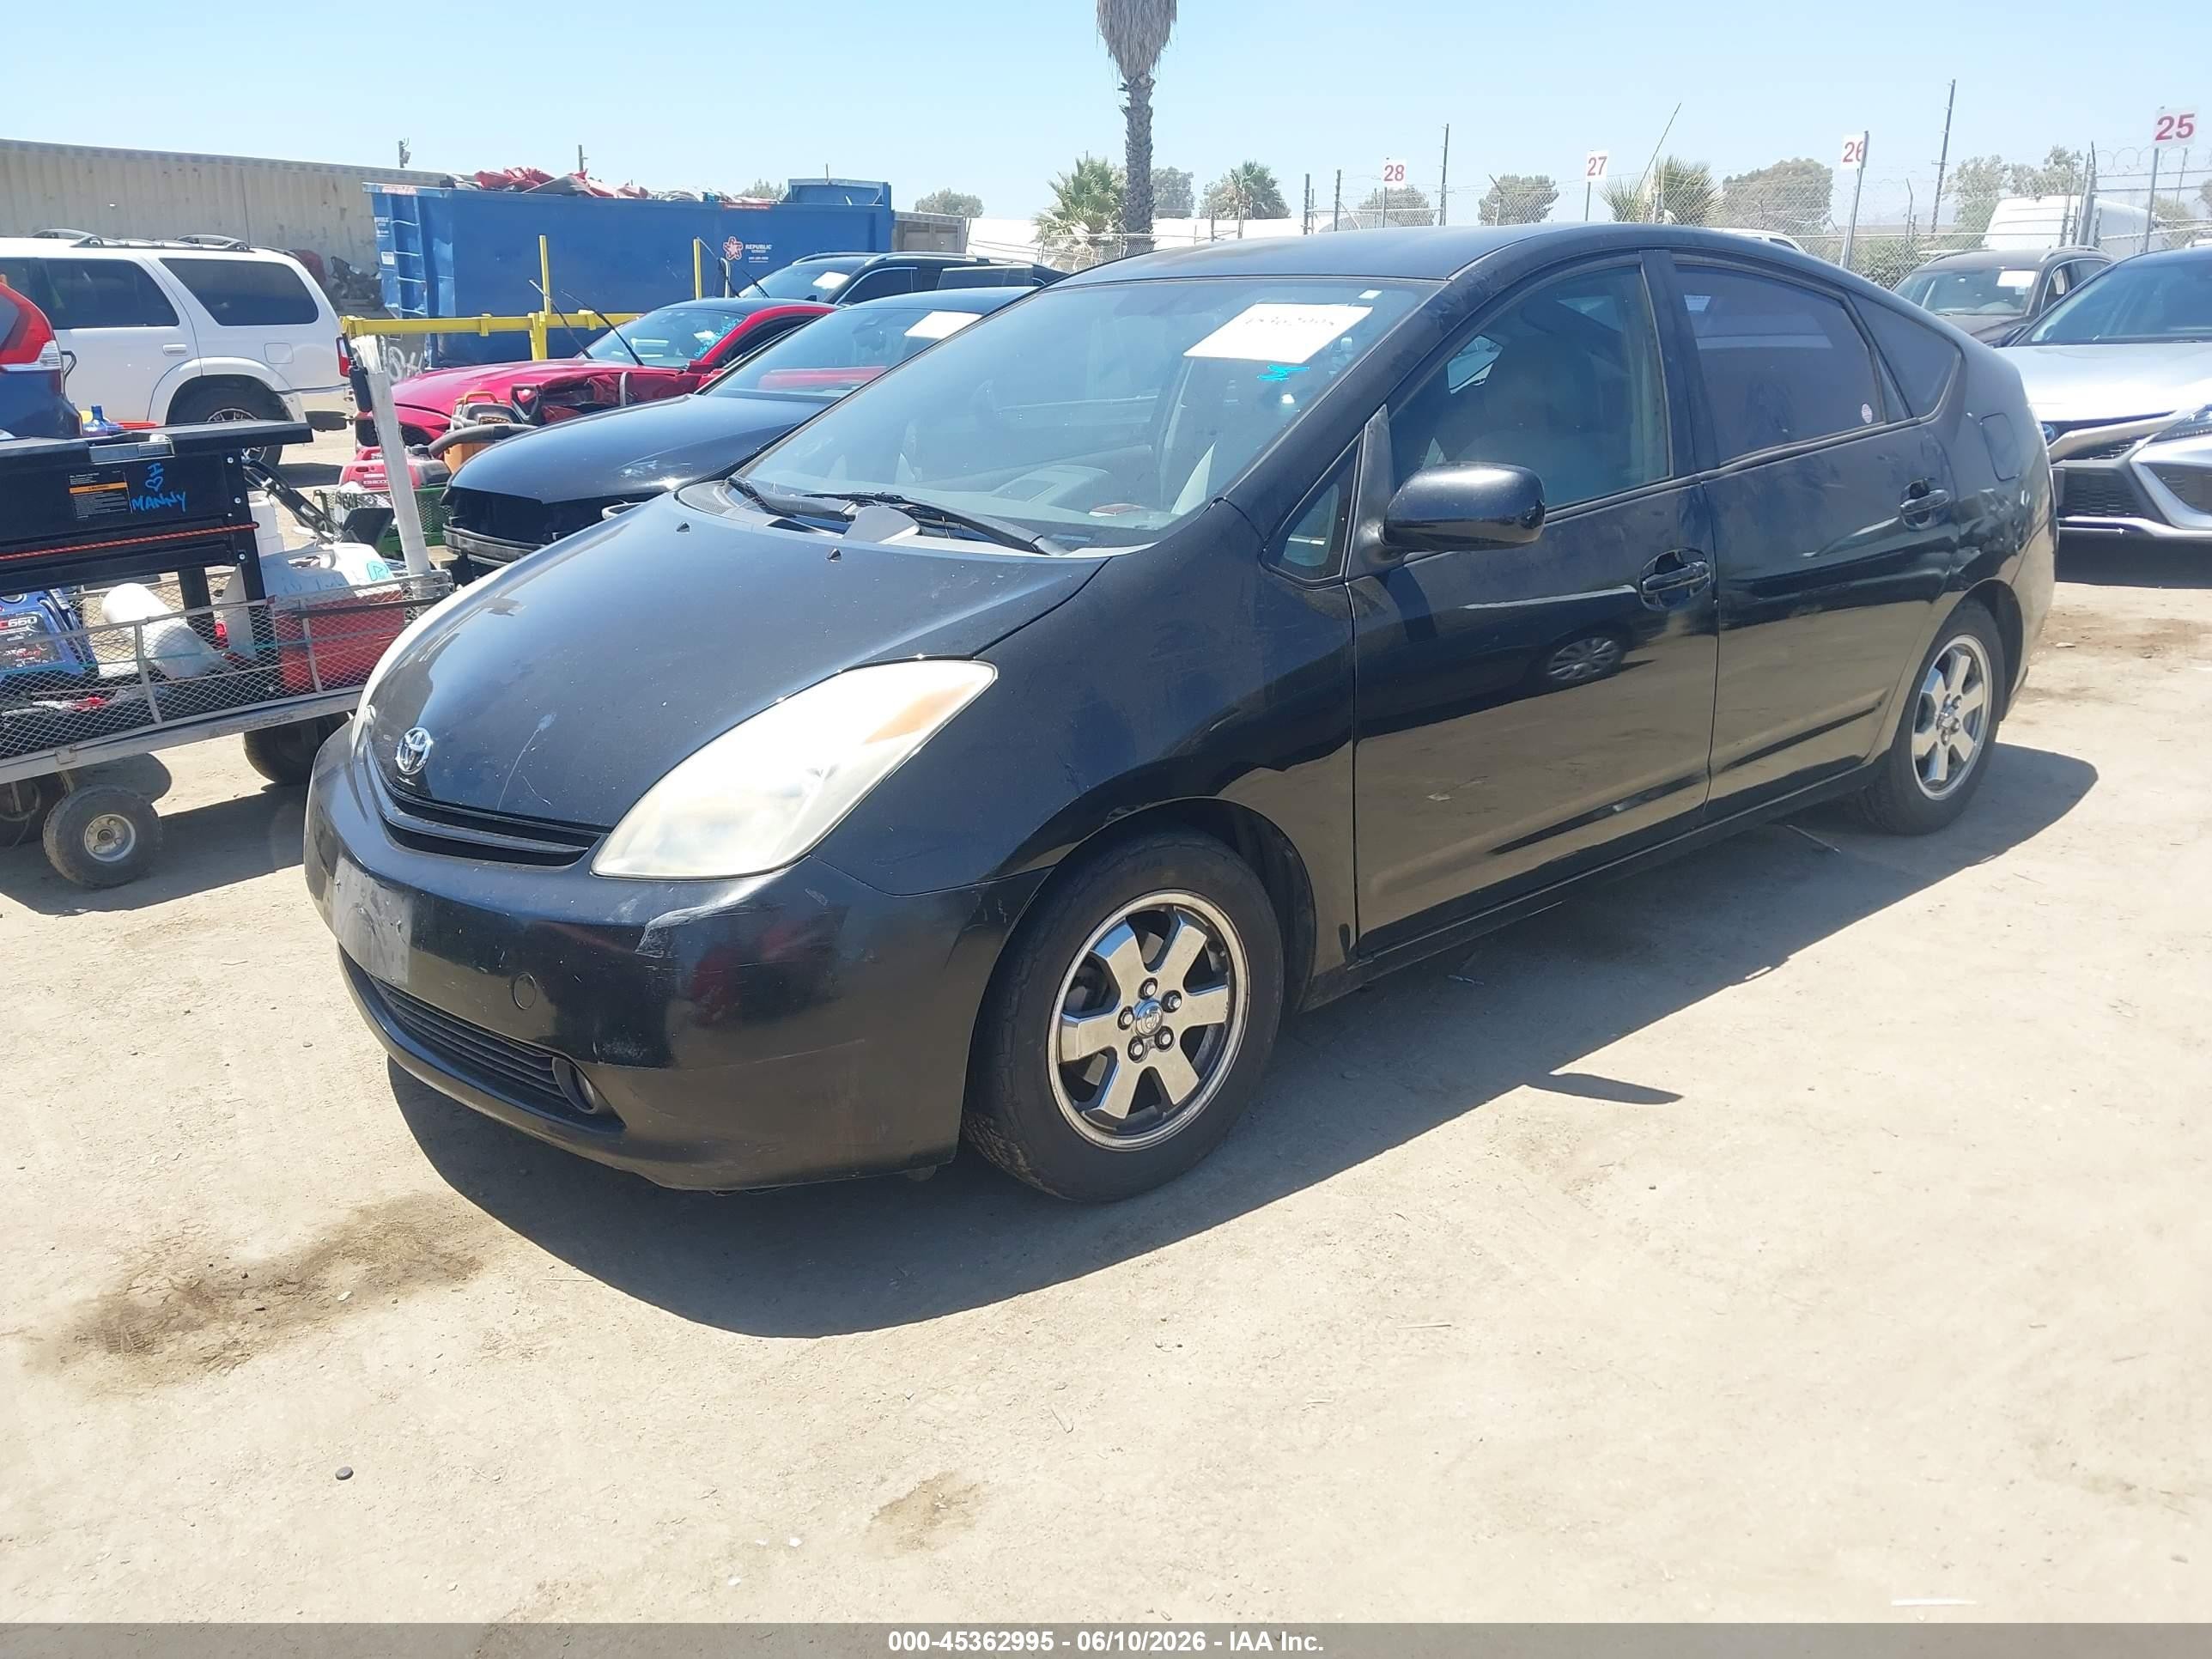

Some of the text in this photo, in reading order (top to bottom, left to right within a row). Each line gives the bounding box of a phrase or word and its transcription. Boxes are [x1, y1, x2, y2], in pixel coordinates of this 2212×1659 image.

[2155, 113, 2195, 141] 25
[1843, 141, 1863, 162] 26
[1383, 164, 1405, 181] 28
[1587, 156, 1607, 176] 27
[147, 462, 164, 477] I
[131, 491, 186, 513] MANNY
